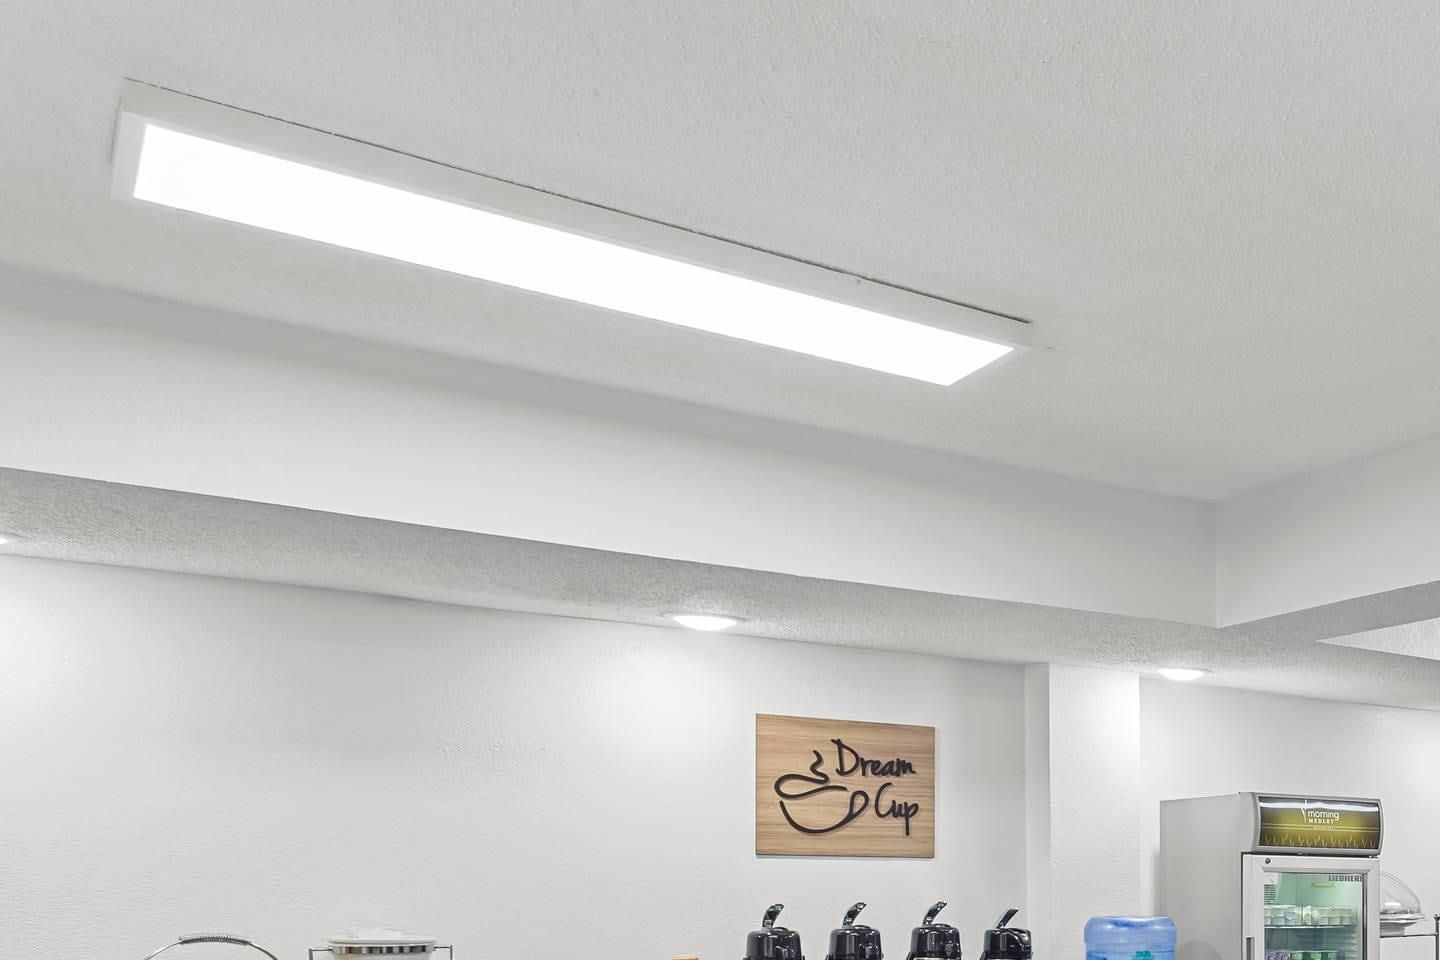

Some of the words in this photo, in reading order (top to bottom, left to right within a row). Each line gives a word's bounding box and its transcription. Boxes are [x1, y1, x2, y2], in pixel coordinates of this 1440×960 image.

[831, 738, 916, 777] Dream
[875, 782, 919, 836] Cup
[1308, 810, 1340, 821] morning
